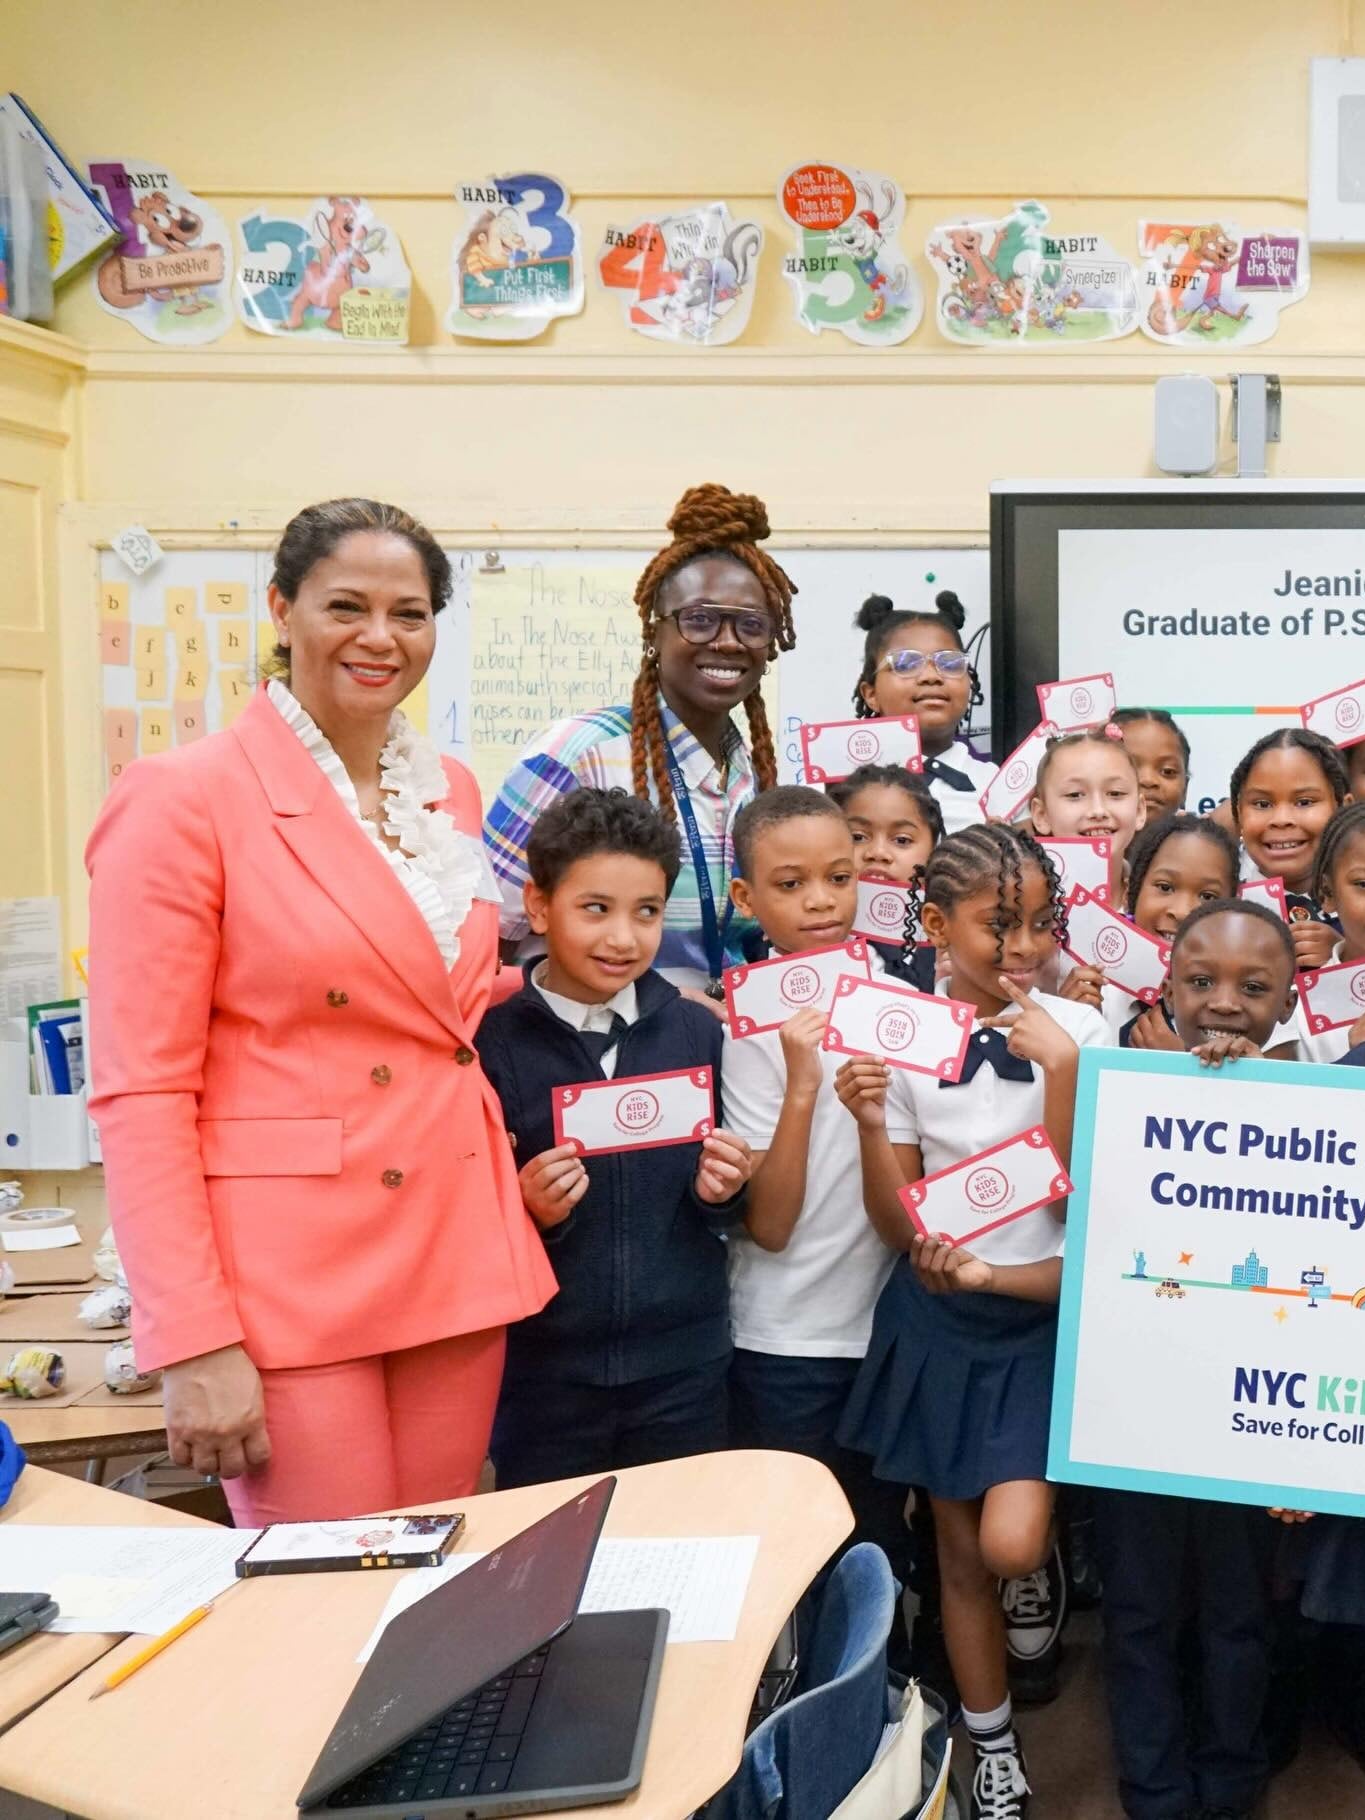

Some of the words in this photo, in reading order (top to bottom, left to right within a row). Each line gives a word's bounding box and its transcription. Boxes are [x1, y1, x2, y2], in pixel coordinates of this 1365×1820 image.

[111, 174, 169, 189] HABIT
[462, 187, 517, 204] HABIT
[605, 229, 657, 252] HABIT
[1045, 237, 1097, 254] HABIT
[1250, 242, 1295, 261] Sharpen
[138, 263, 153, 278] Be
[156, 259, 210, 277] Proactive
[786, 257, 838, 272] HABIT
[1247, 261, 1265, 276] the
[243, 268, 296, 287] HABIT
[504, 269, 522, 285] Put
[528, 267, 556, 285] First
[1065, 269, 1117, 289] Synergize
[494, 285, 532, 303] Things
[347, 321, 366, 336] End
[578, 577, 633, 608] Nose
[108, 595, 119, 609] b
[176, 603, 185, 614] c
[1123, 608, 1270, 636] Graduate
[1281, 608, 1313, 636] of
[228, 633, 239, 647] h
[492, 617, 512, 645] In
[553, 618, 594, 646] Nose
[112, 636, 120, 647] e
[187, 638, 197, 653] g
[473, 643, 523, 670] about
[540, 645, 569, 670] the
[185, 672, 196, 686] k
[151, 724, 161, 735] n
[185, 717, 195, 728] o
[1144, 1116, 1228, 1154] NYC
[1239, 1124, 1357, 1166] Public
[1233, 1367, 1307, 1408] NYC
[1231, 1412, 1283, 1436] Save
[1288, 1418, 1319, 1441] for
